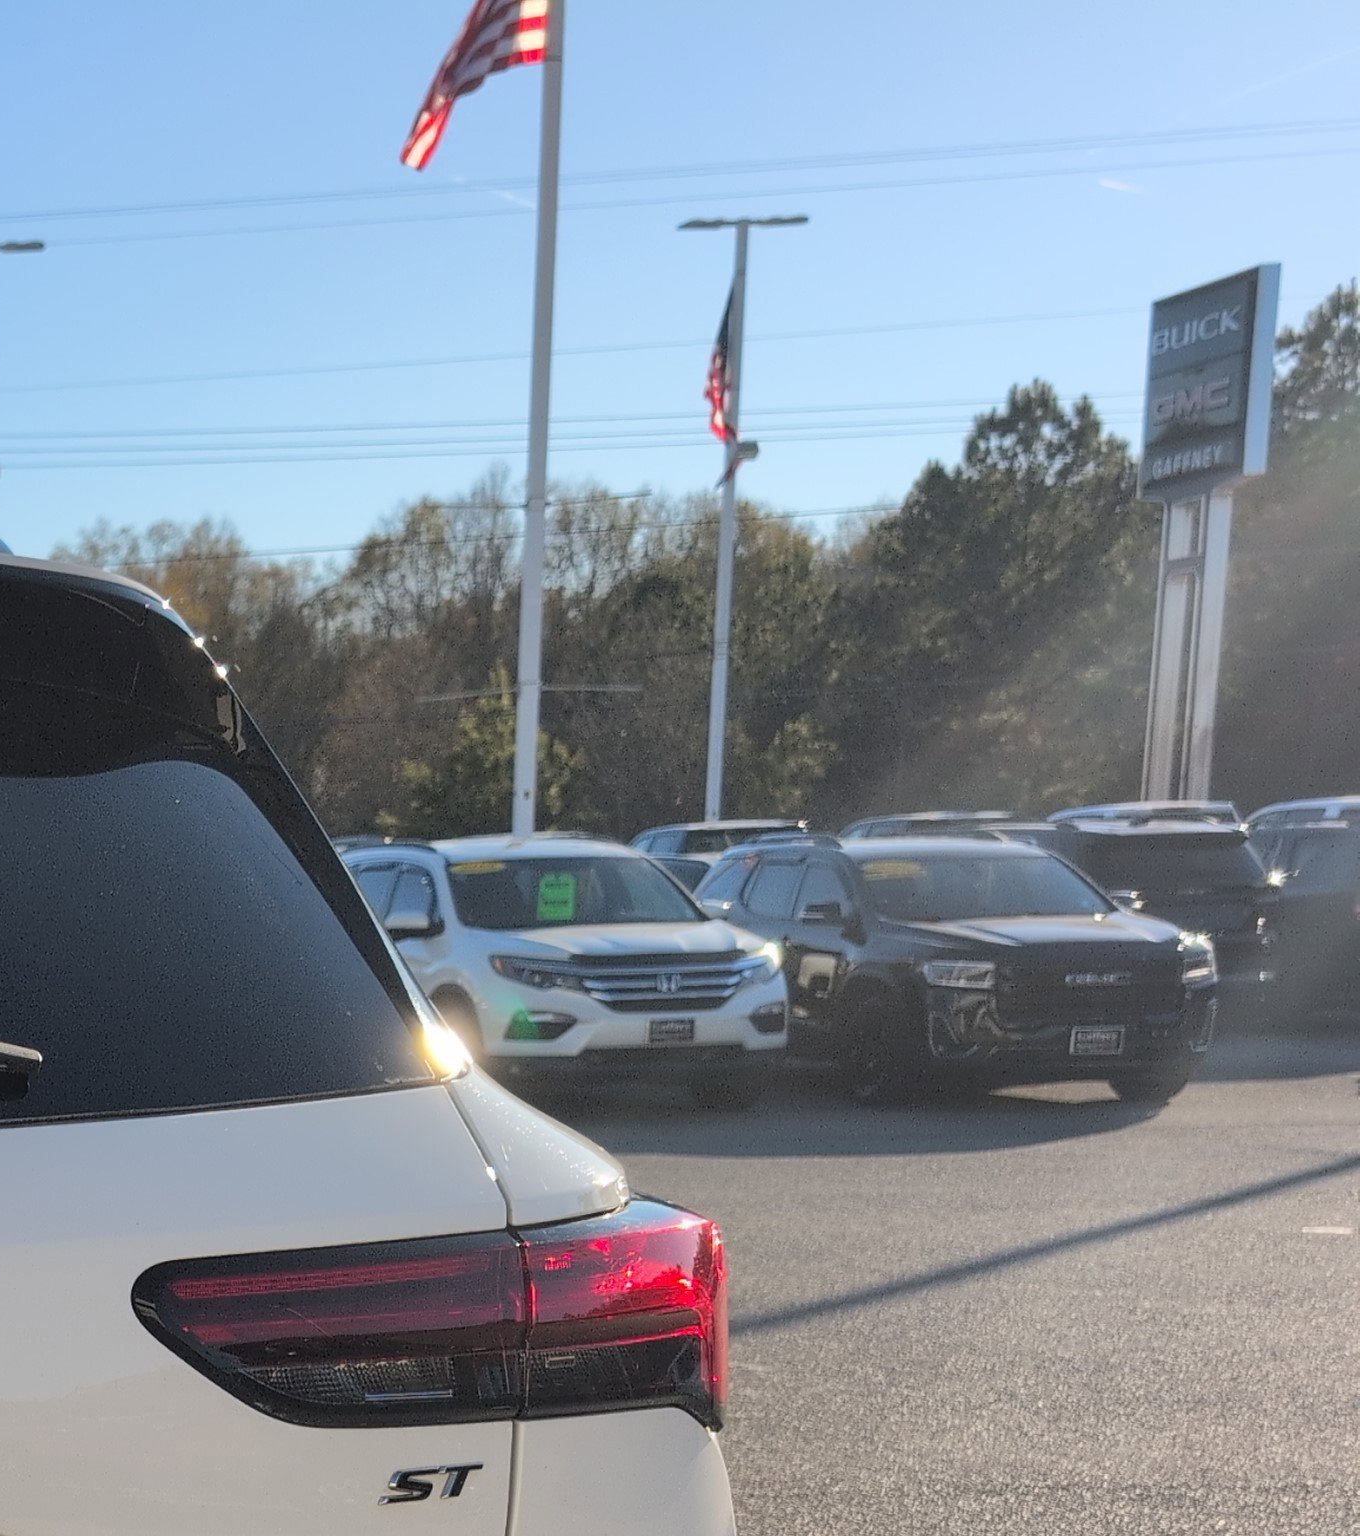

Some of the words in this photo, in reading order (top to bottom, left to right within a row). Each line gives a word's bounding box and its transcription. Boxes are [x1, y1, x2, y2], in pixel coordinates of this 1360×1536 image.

[1153, 305, 1242, 356] BUICK
[1152, 377, 1229, 423] GMC
[377, 1460, 485, 1507] ST
